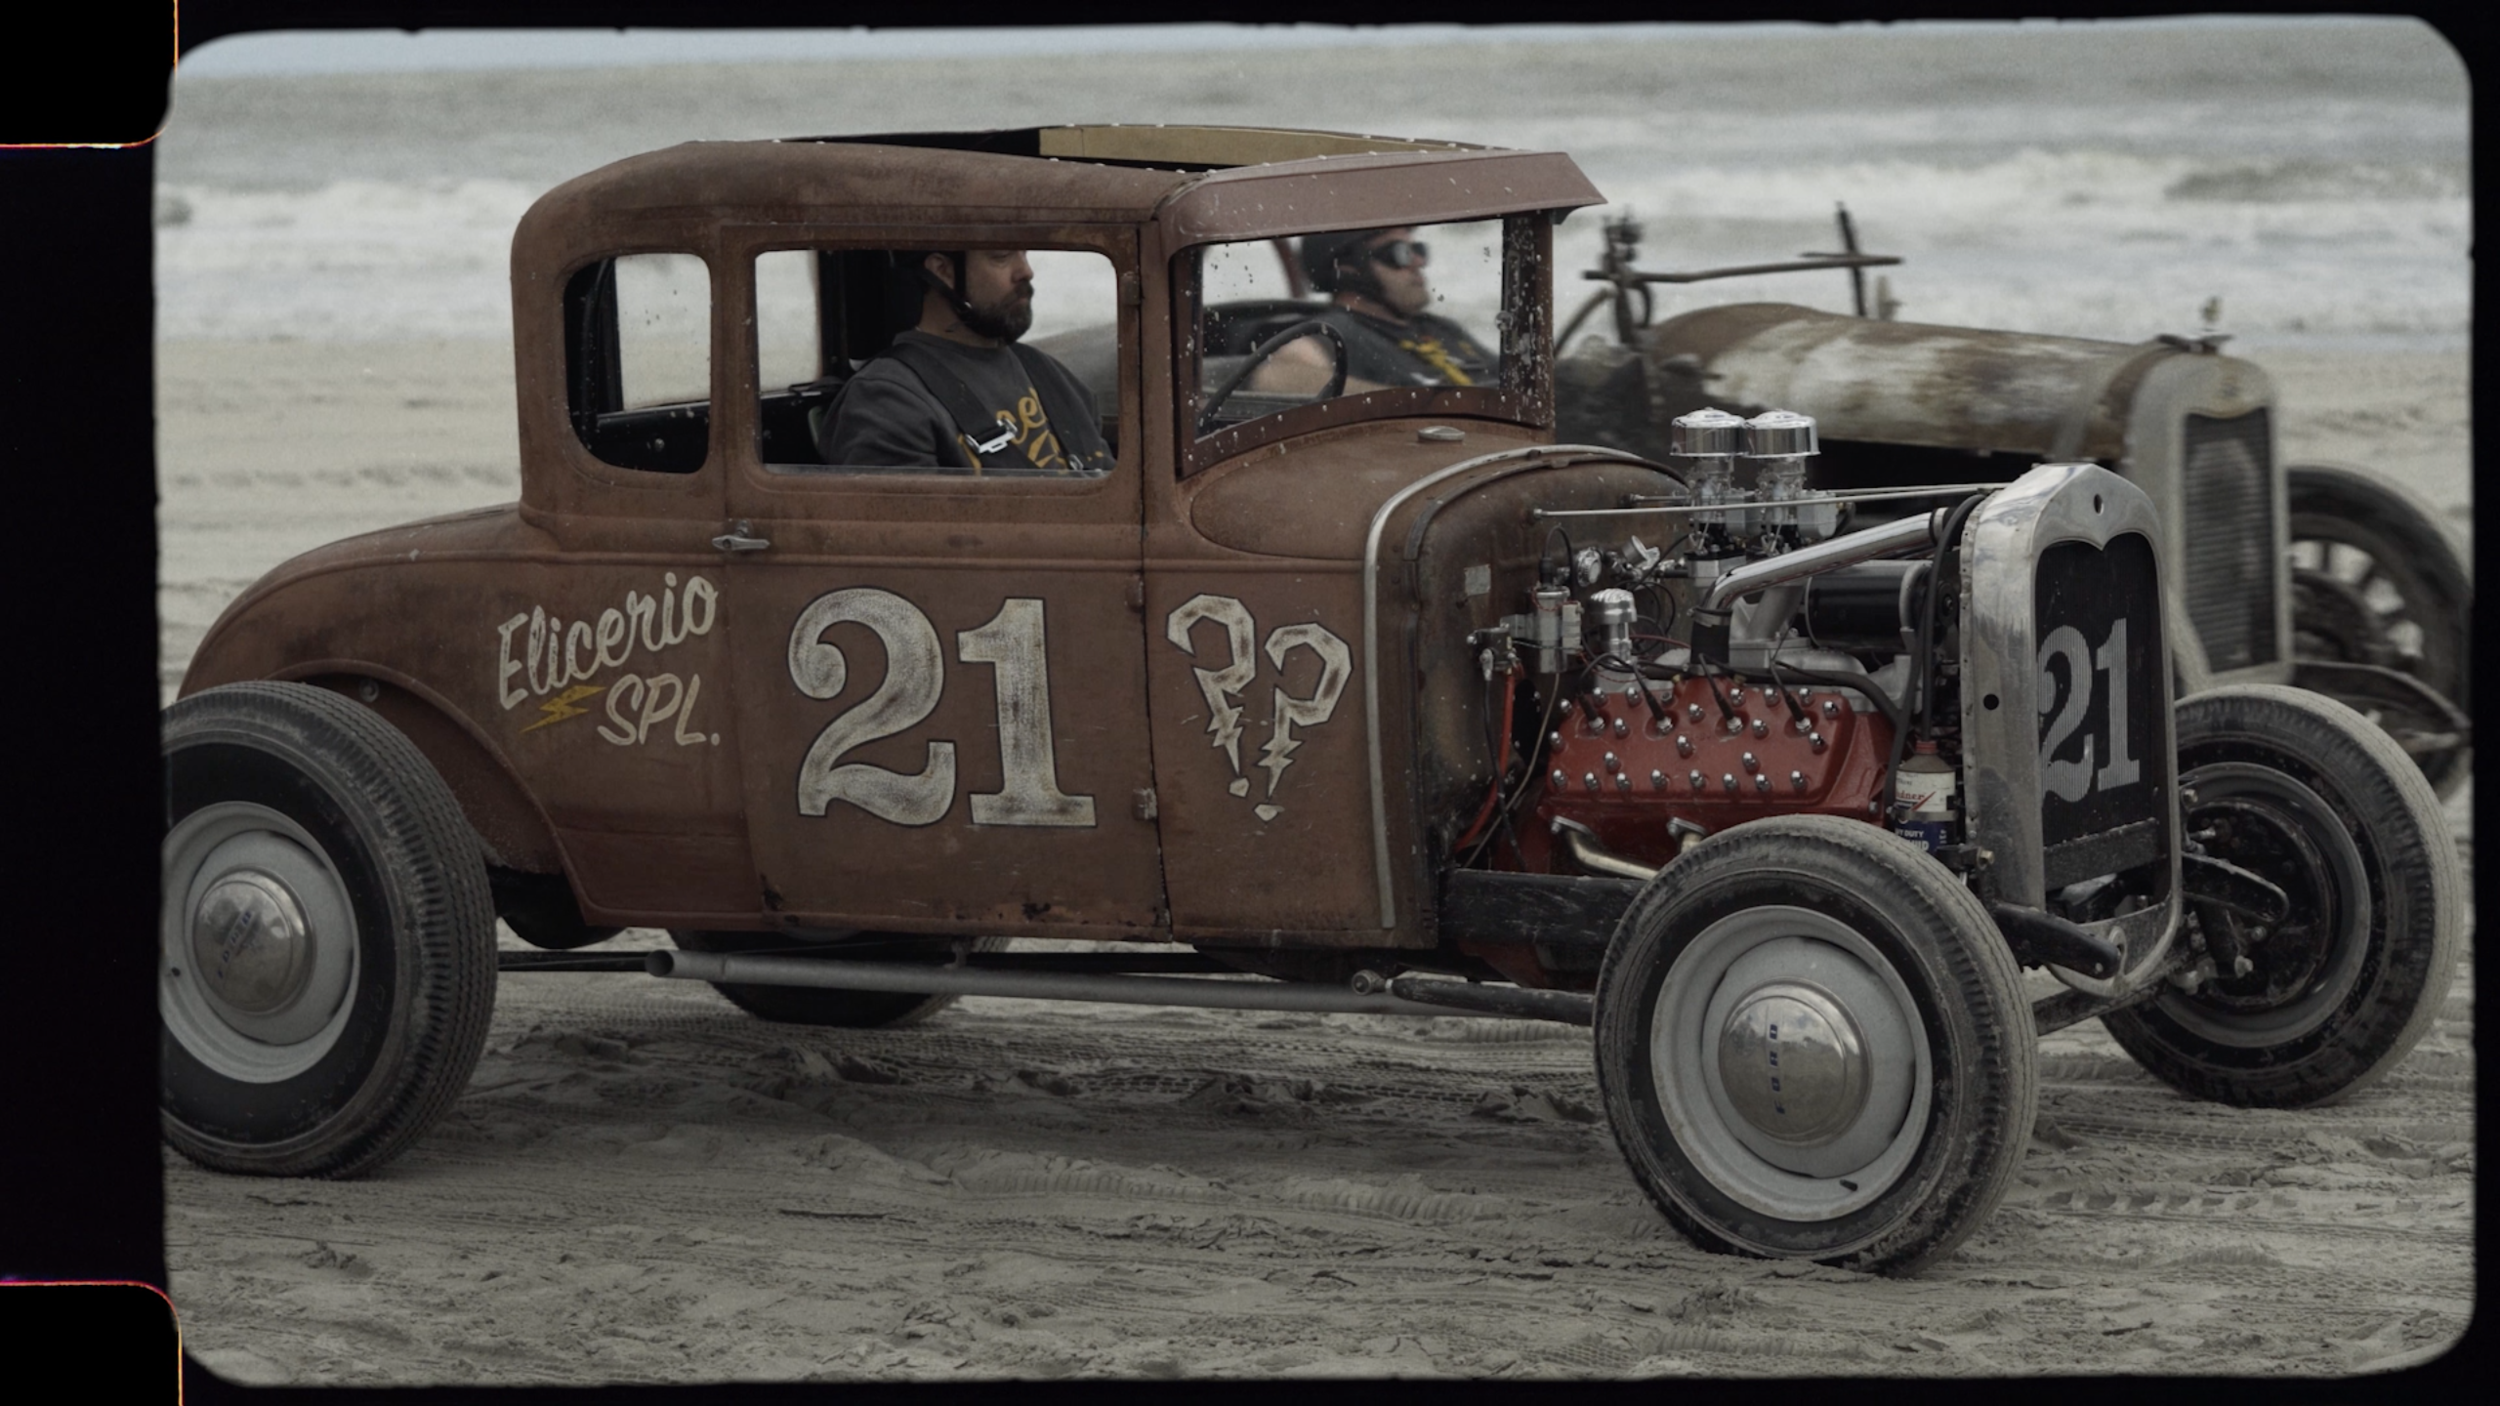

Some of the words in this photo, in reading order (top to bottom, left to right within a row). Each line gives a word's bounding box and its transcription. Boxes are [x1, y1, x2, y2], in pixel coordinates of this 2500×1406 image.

[498, 572, 718, 710] Elicerio
[597, 673, 720, 746] SPL.
[788, 587, 1097, 826] 21
[2037, 617, 2140, 802] 21
[1904, 829, 1924, 838] DUTY
[1769, 1023, 1786, 1115] FORD
